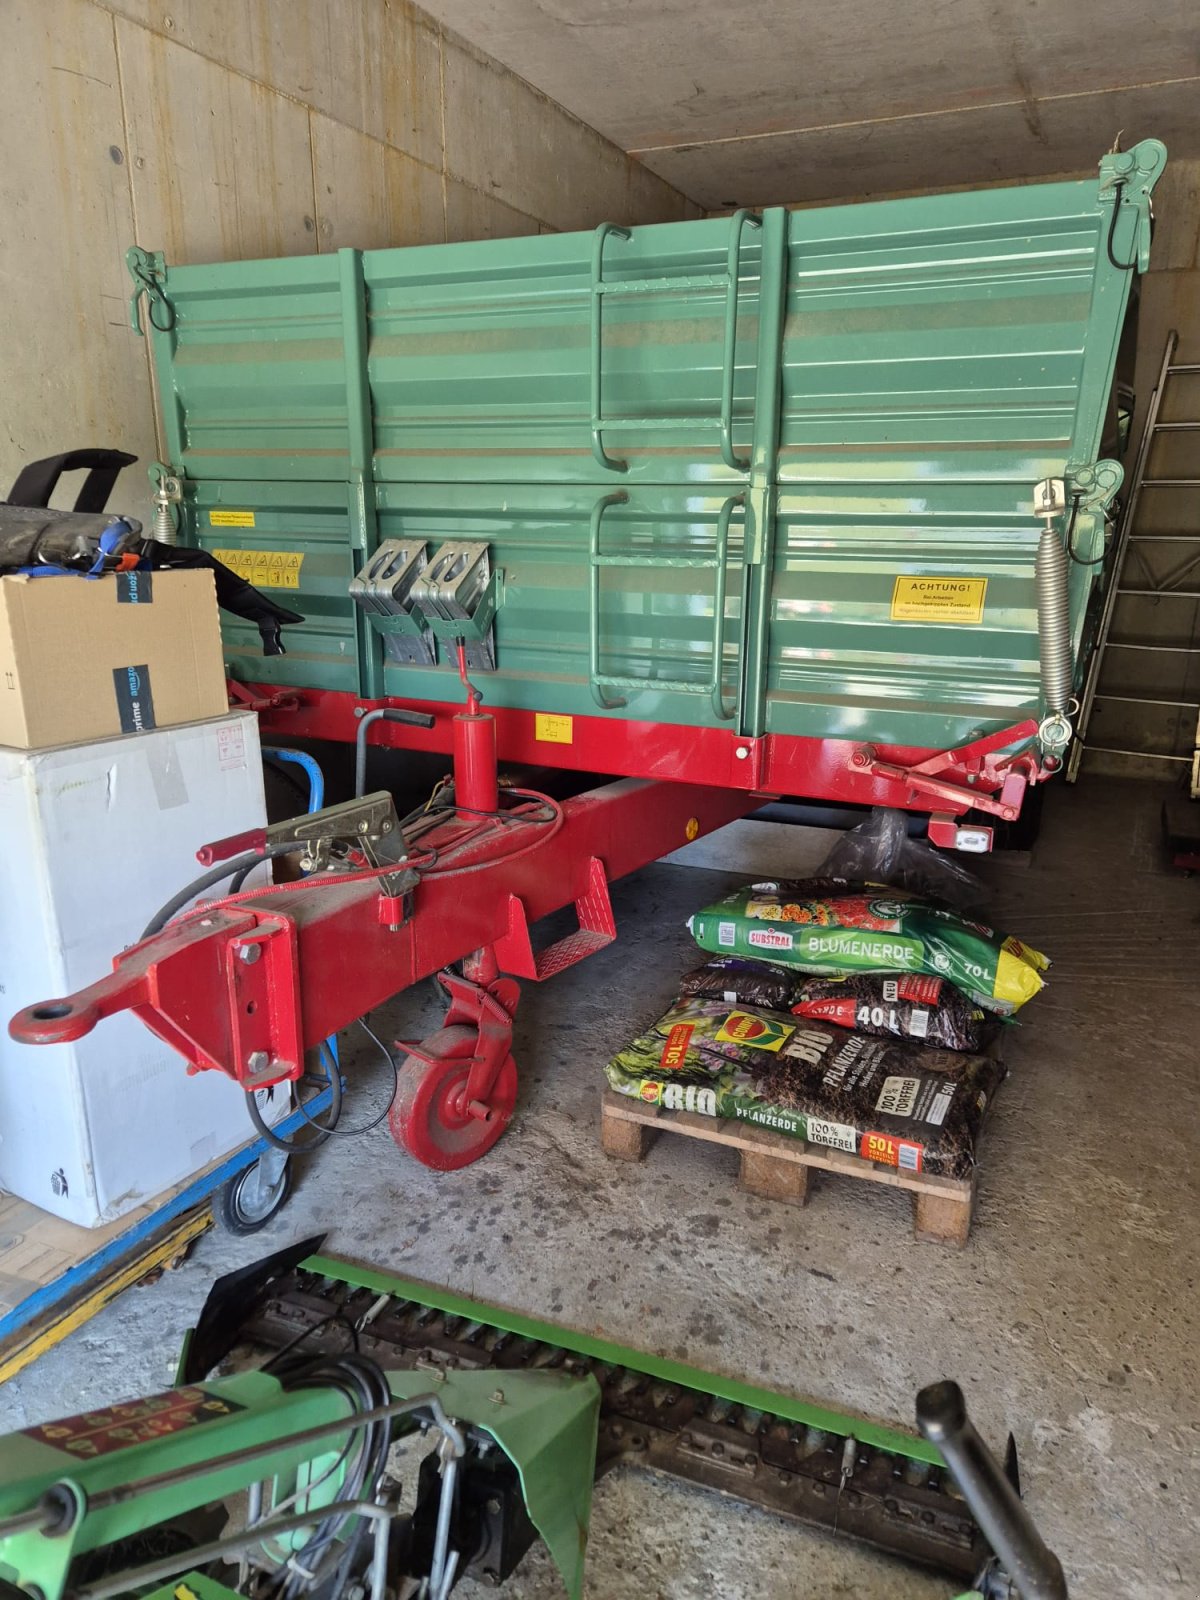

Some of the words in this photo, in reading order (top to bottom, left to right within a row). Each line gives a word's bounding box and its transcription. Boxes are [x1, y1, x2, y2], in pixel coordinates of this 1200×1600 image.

[911, 583, 971, 592] ACHTUNG!
[132, 702, 144, 732] prime
[751, 933, 791, 947] SUBSTRAL
[809, 937, 914, 960] BLUMENERDE
[886, 982, 896, 999] NEU
[785, 1029, 834, 1066] BIO
[822, 1035, 866, 1088] PFLANZERDE
[895, 1080, 916, 1113] TORFFREI
[736, 1107, 797, 1132] PFLANZERDE
[811, 1133, 853, 1150] TORFFREI
